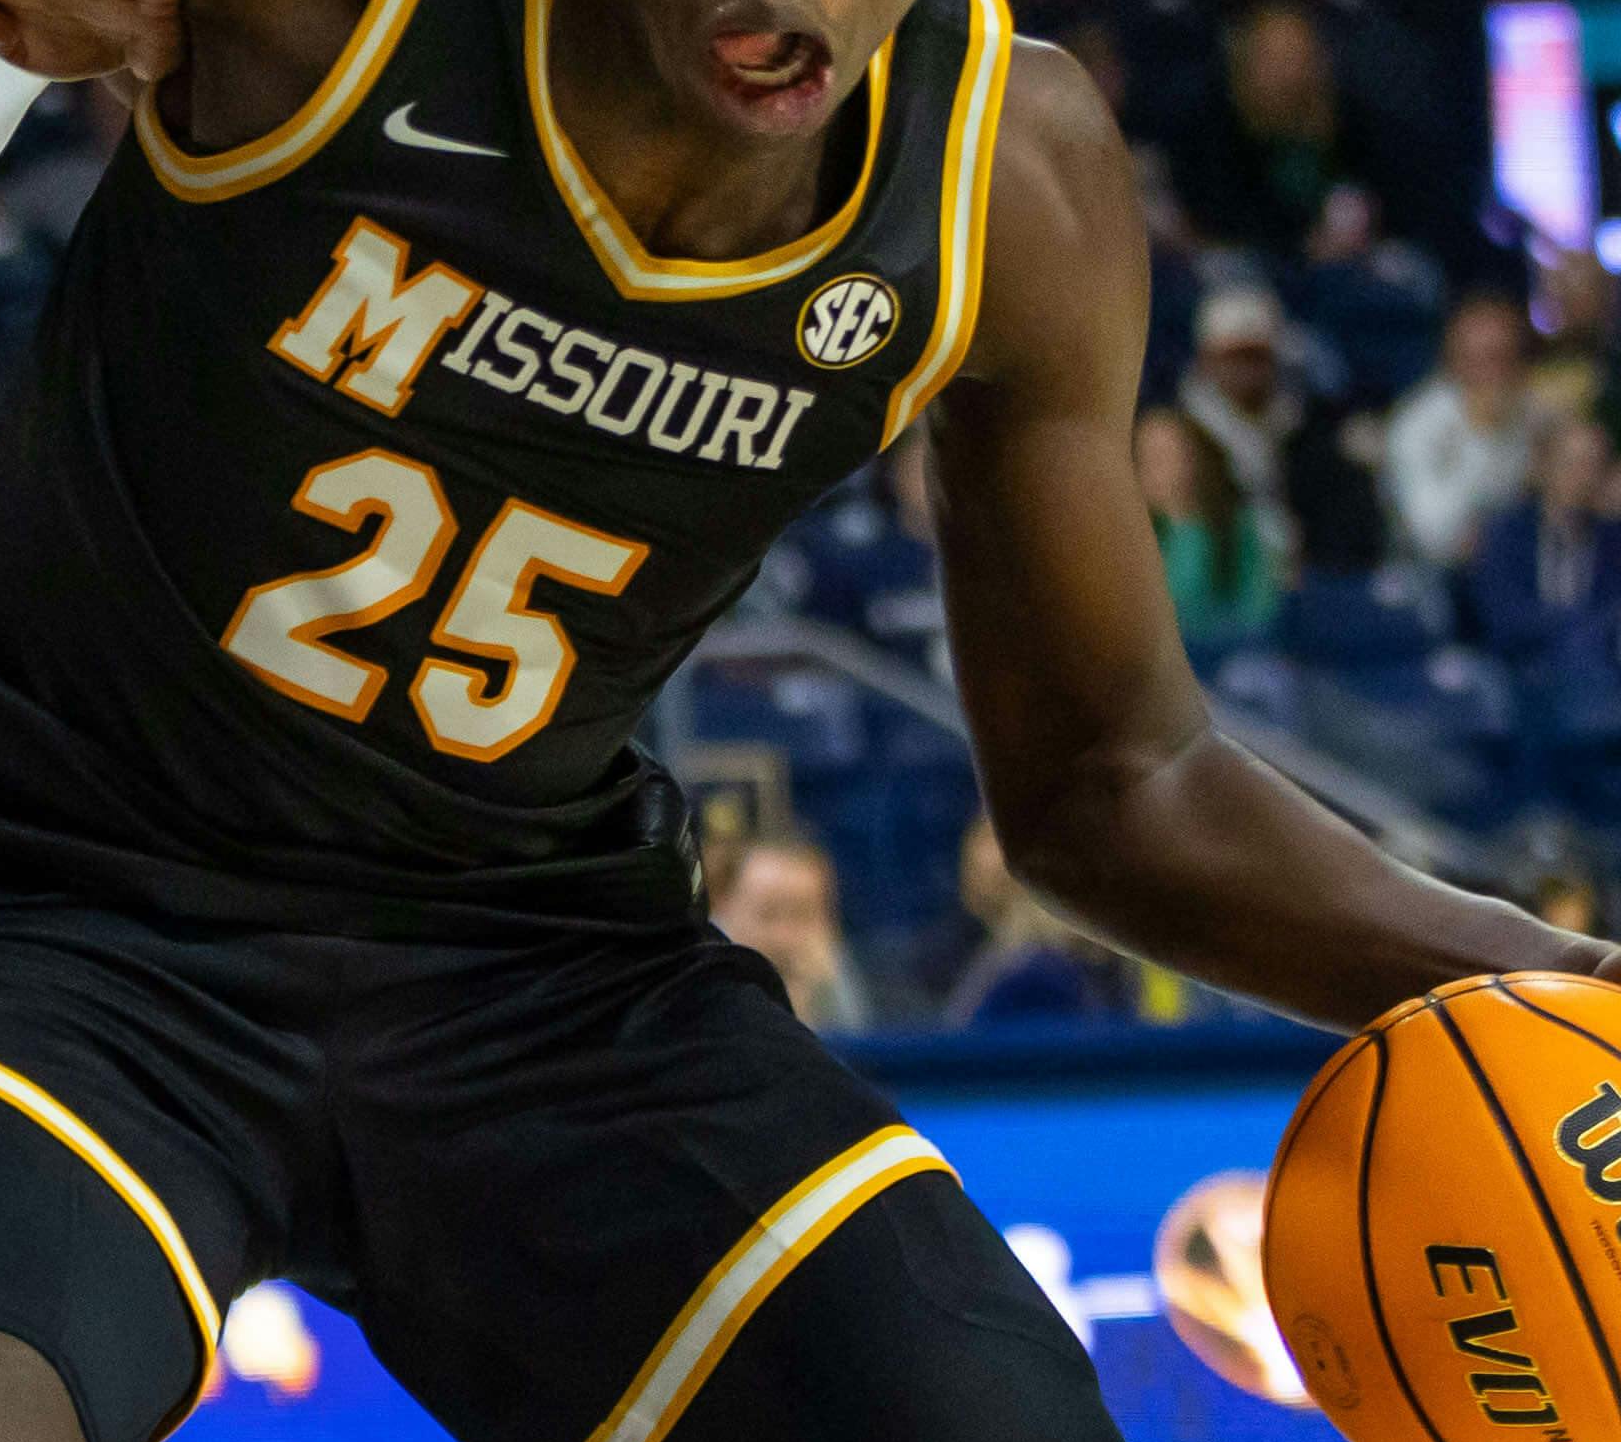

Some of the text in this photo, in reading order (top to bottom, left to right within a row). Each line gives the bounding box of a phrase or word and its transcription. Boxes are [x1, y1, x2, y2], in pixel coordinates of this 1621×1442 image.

[266, 215, 814, 470] MISSOURI
[803, 280, 893, 363] SEC
[219, 448, 650, 764] 25
[1424, 1244, 1559, 1430] EVO
